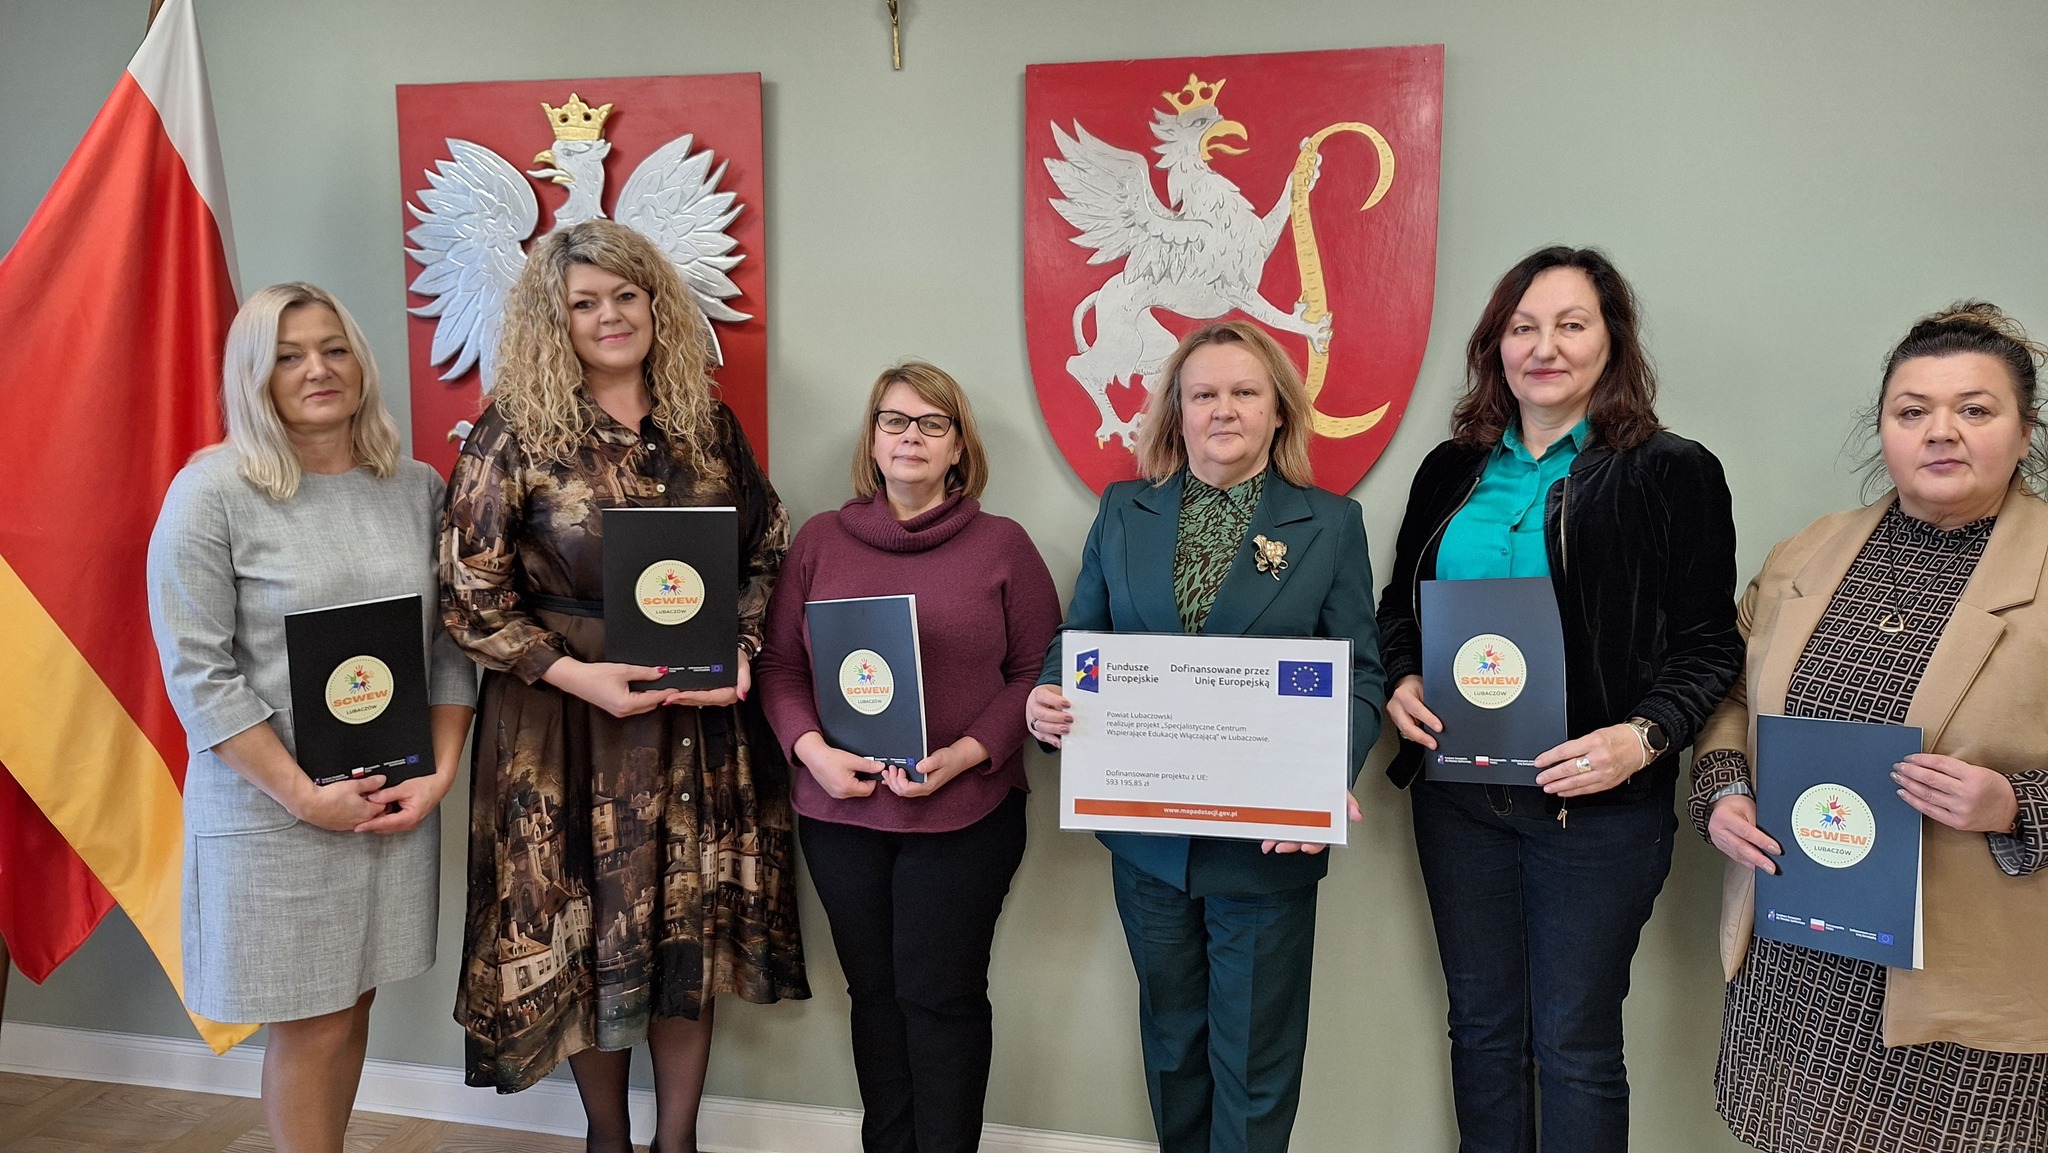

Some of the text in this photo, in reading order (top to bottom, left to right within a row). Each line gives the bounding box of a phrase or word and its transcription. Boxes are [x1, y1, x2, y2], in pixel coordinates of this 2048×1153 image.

[643, 597, 698, 605] SCWEW
[1106, 662, 1150, 672] Fundusze
[1170, 664, 1270, 677] Dofinansowane przez
[1106, 674, 1159, 684] Europejskie
[1194, 676, 1270, 689] Unię Europejską
[1461, 676, 1520, 685] SCWEW
[846, 686, 890, 695] SCWEW
[333, 689, 389, 708] SCWEW
[346, 704, 378, 715] LUBACZÓW
[1106, 711, 1173, 720] Powiat Lubaczowski
[1106, 720, 1135, 728] realizuje
[1136, 721, 1160, 729] projekt
[1216, 724, 1247, 732] Centrum
[1106, 728, 1147, 738] Wspierające
[1148, 730, 1178, 739] Edukację
[1105, 769, 1160, 779] Dofinansowanie
[1161, 772, 1190, 781] projektu
[1105, 778, 1119, 786] 593
[1120, 779, 1142, 787] 195,85
[1163, 807, 1238, 818] www.mapadotacji.gov.pl
[1800, 827, 1868, 846] SCWEW
[1813, 845, 1852, 857] LUBACZÓW
